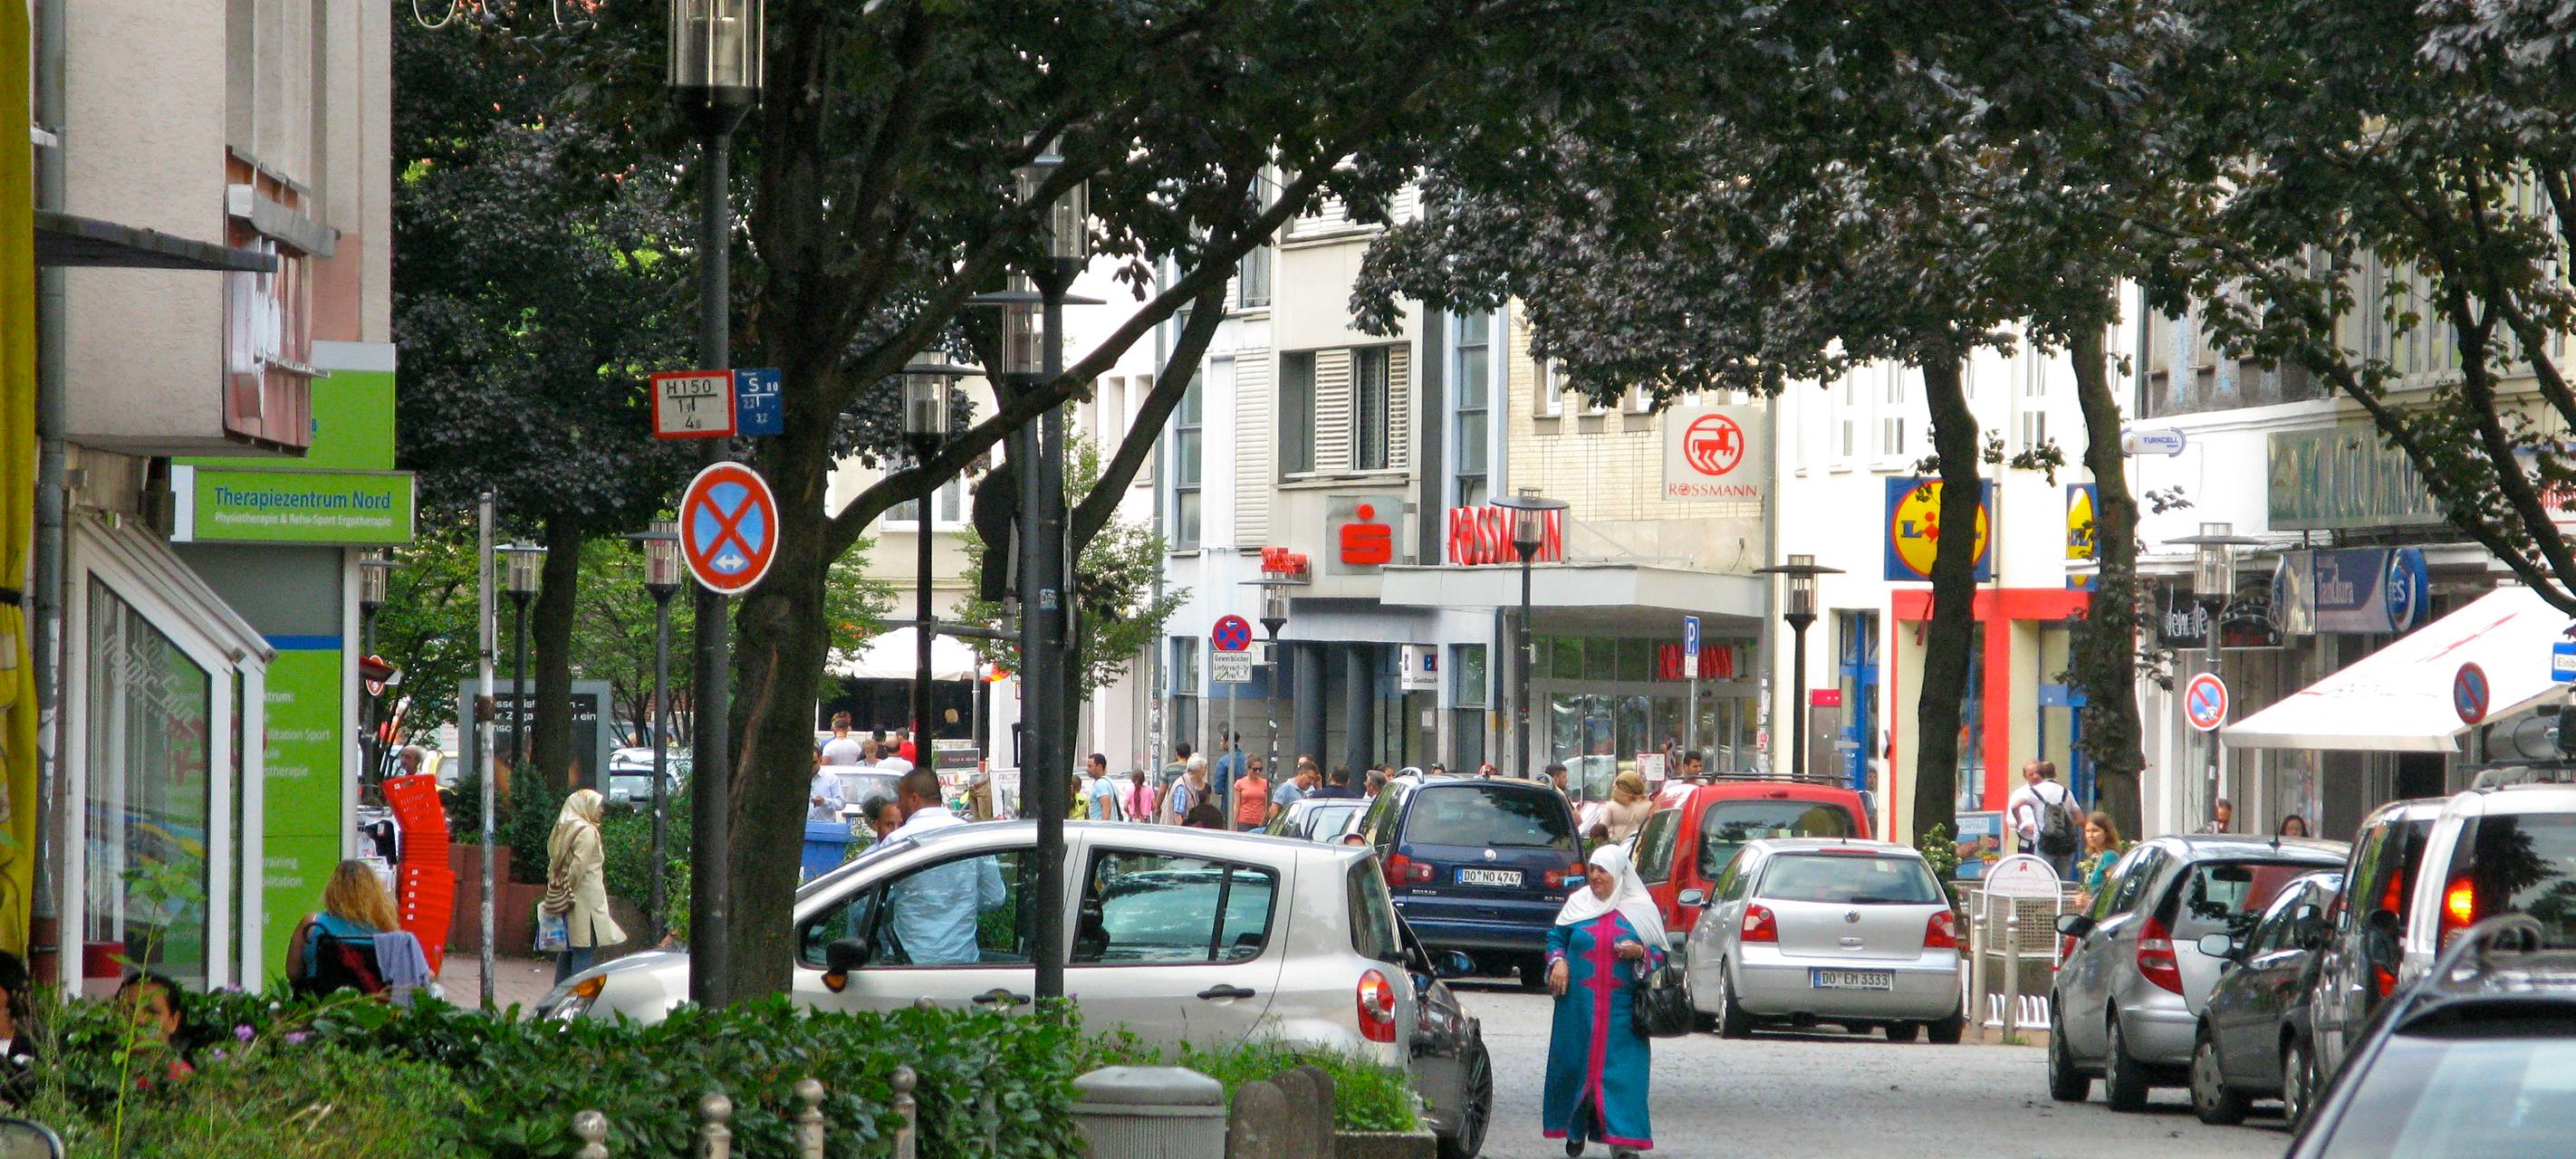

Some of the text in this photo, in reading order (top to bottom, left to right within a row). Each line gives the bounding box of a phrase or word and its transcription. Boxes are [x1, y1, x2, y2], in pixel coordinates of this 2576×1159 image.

[666, 379, 711, 395] H150
[748, 378, 759, 392] S
[1668, 484, 1757, 497] ROSSMANN
[215, 486, 391, 511] Therapiezentrum Nord
[1687, 622, 1697, 653] P
[580, 711, 596, 721] ein
[1464, 871, 1476, 882] DO
[1497, 873, 1521, 883] 4747
[1822, 972, 1836, 983] DO
[1861, 973, 1889, 986] 3333
